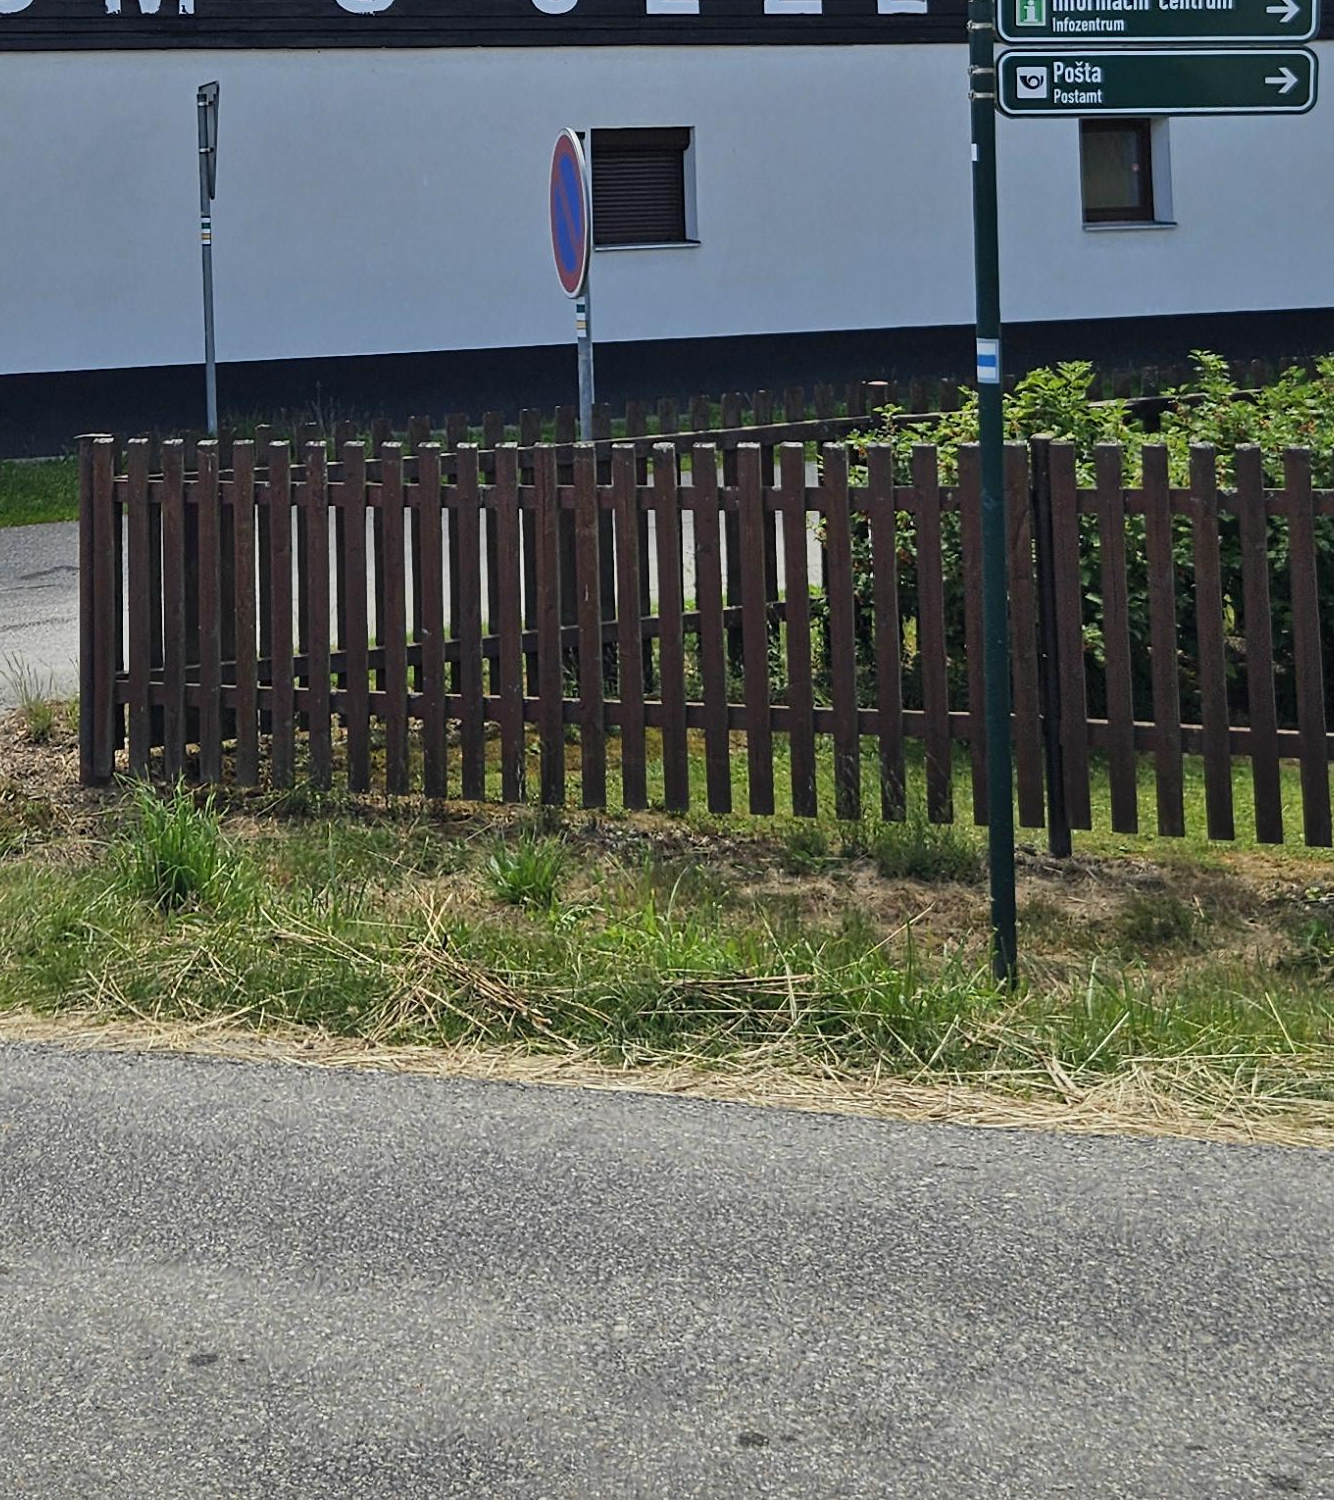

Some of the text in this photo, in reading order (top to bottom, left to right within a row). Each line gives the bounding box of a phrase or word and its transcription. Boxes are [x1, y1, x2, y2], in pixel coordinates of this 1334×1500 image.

[1052, 17, 1125, 32] Infozentrum
[1053, 61, 1102, 84] Pošta
[1053, 89, 1102, 104] Postamt
